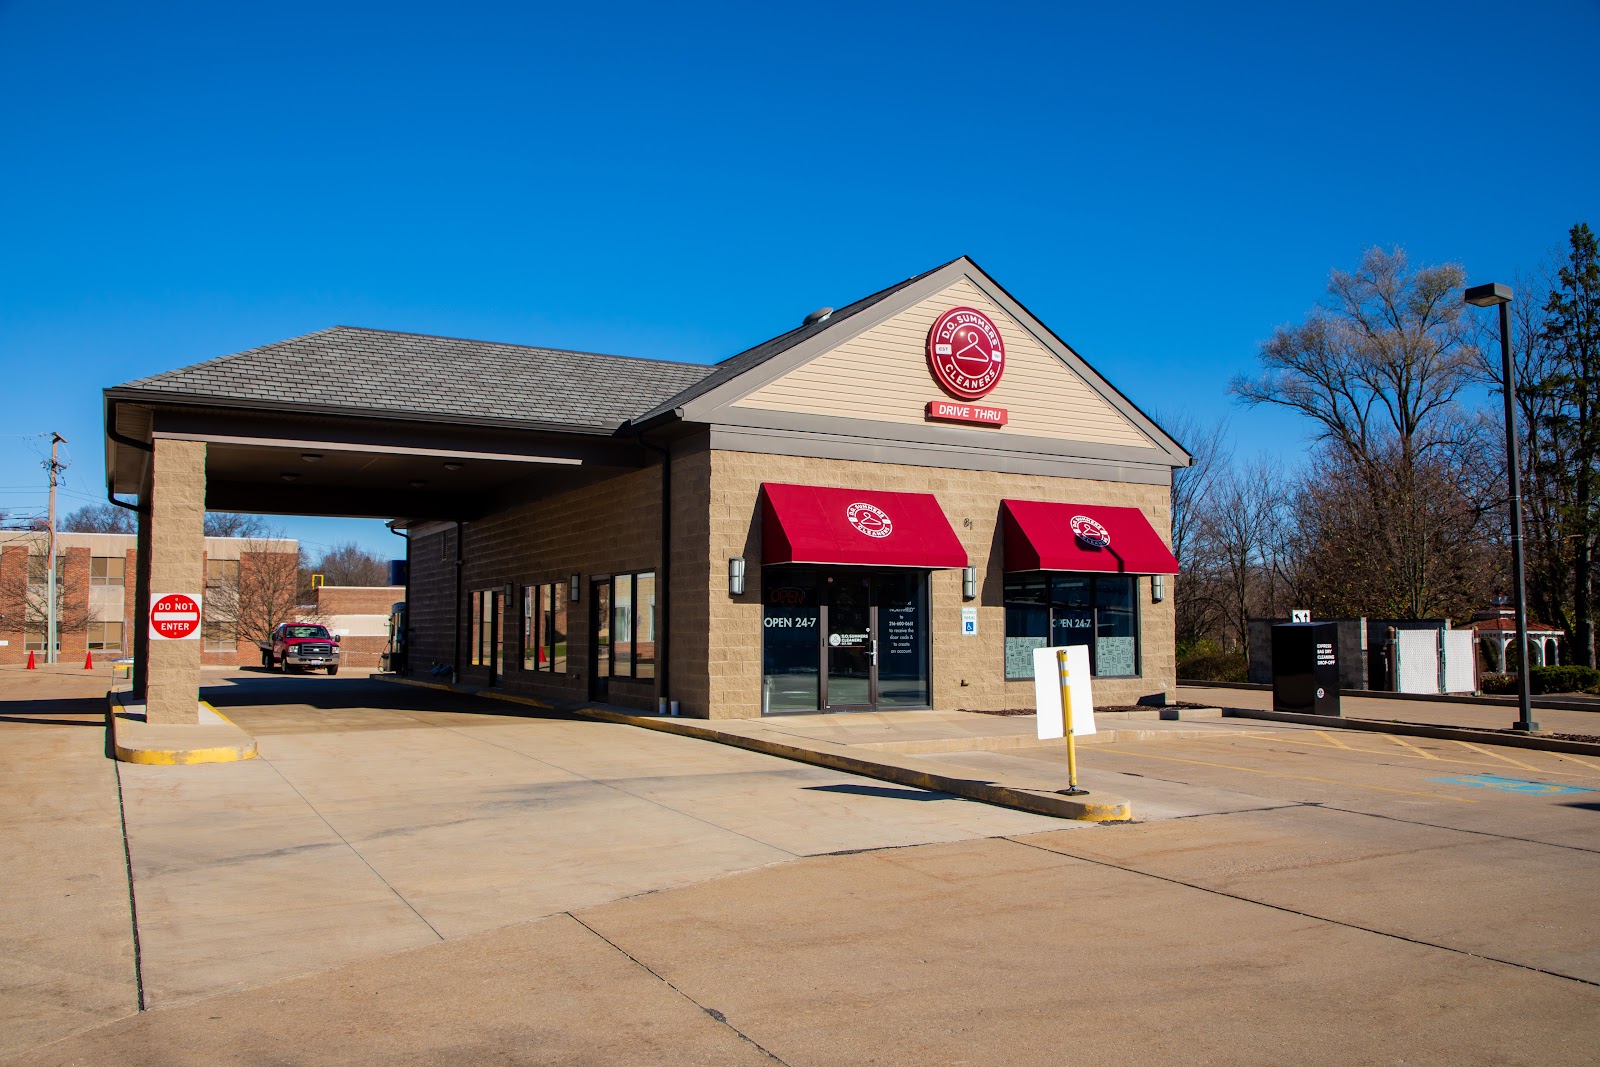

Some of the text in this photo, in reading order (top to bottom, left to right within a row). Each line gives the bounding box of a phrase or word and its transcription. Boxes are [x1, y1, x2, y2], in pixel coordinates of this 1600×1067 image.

[942, 314, 998, 346] D.O. SUMMERS
[945, 363, 995, 389] CLEANERS
[938, 404, 1002, 421] DRIVE THRU
[158, 602, 194, 611] DO NOT
[160, 622, 190, 631] ENTER
[764, 617, 817, 628] OPEN 24-7
[1074, 618, 1092, 628] 24-7
